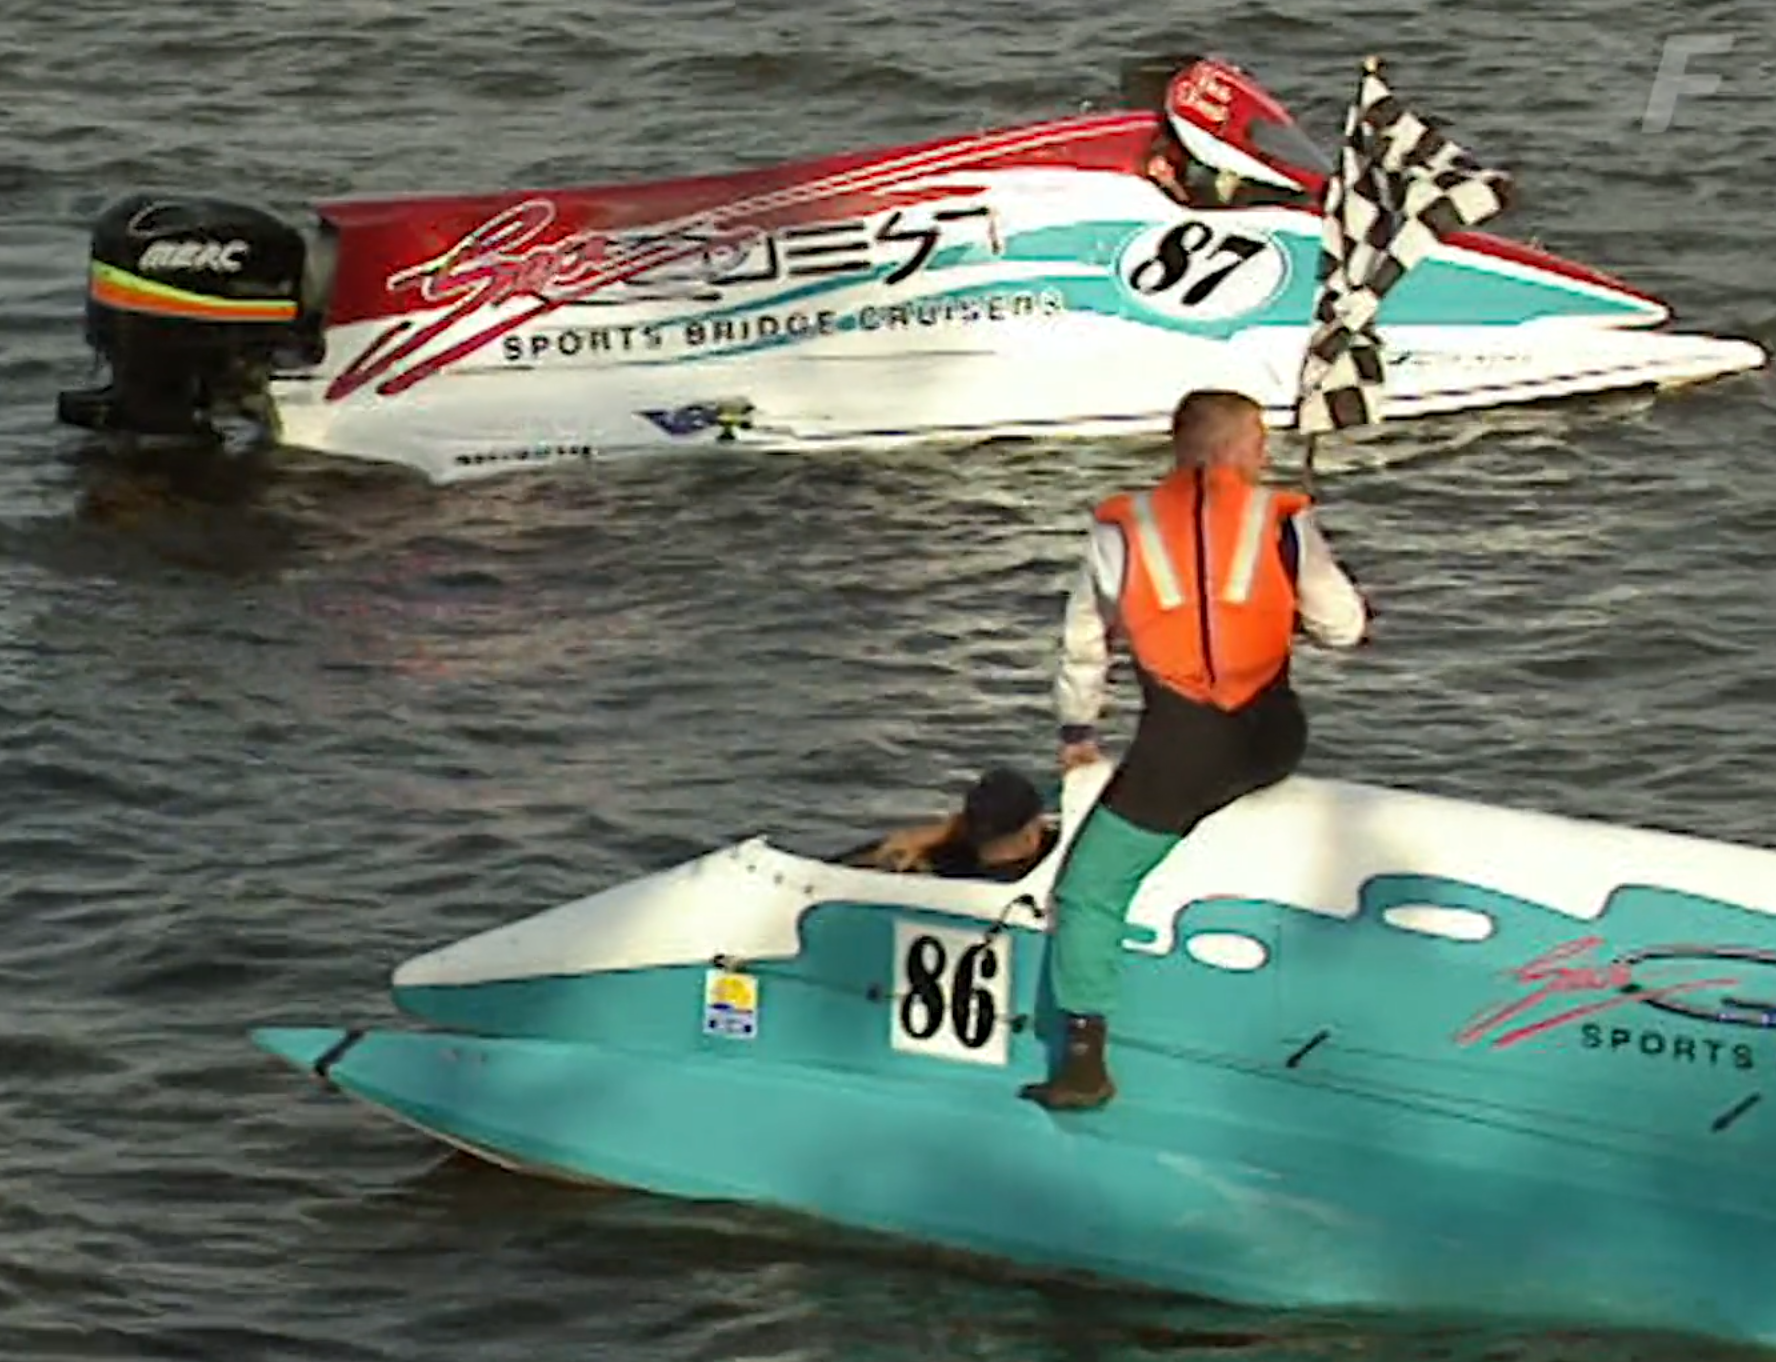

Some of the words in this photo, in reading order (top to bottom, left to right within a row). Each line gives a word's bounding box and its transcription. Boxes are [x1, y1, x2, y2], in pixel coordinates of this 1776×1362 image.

[139, 238, 249, 273] MERC
[1129, 221, 1267, 306] 87
[503, 325, 662, 361] SPORTS
[685, 309, 837, 347] BRIDGE
[859, 288, 1062, 331] CRUISERS
[902, 935, 998, 1049] 86
[1580, 1021, 1754, 1069] SPORTS
